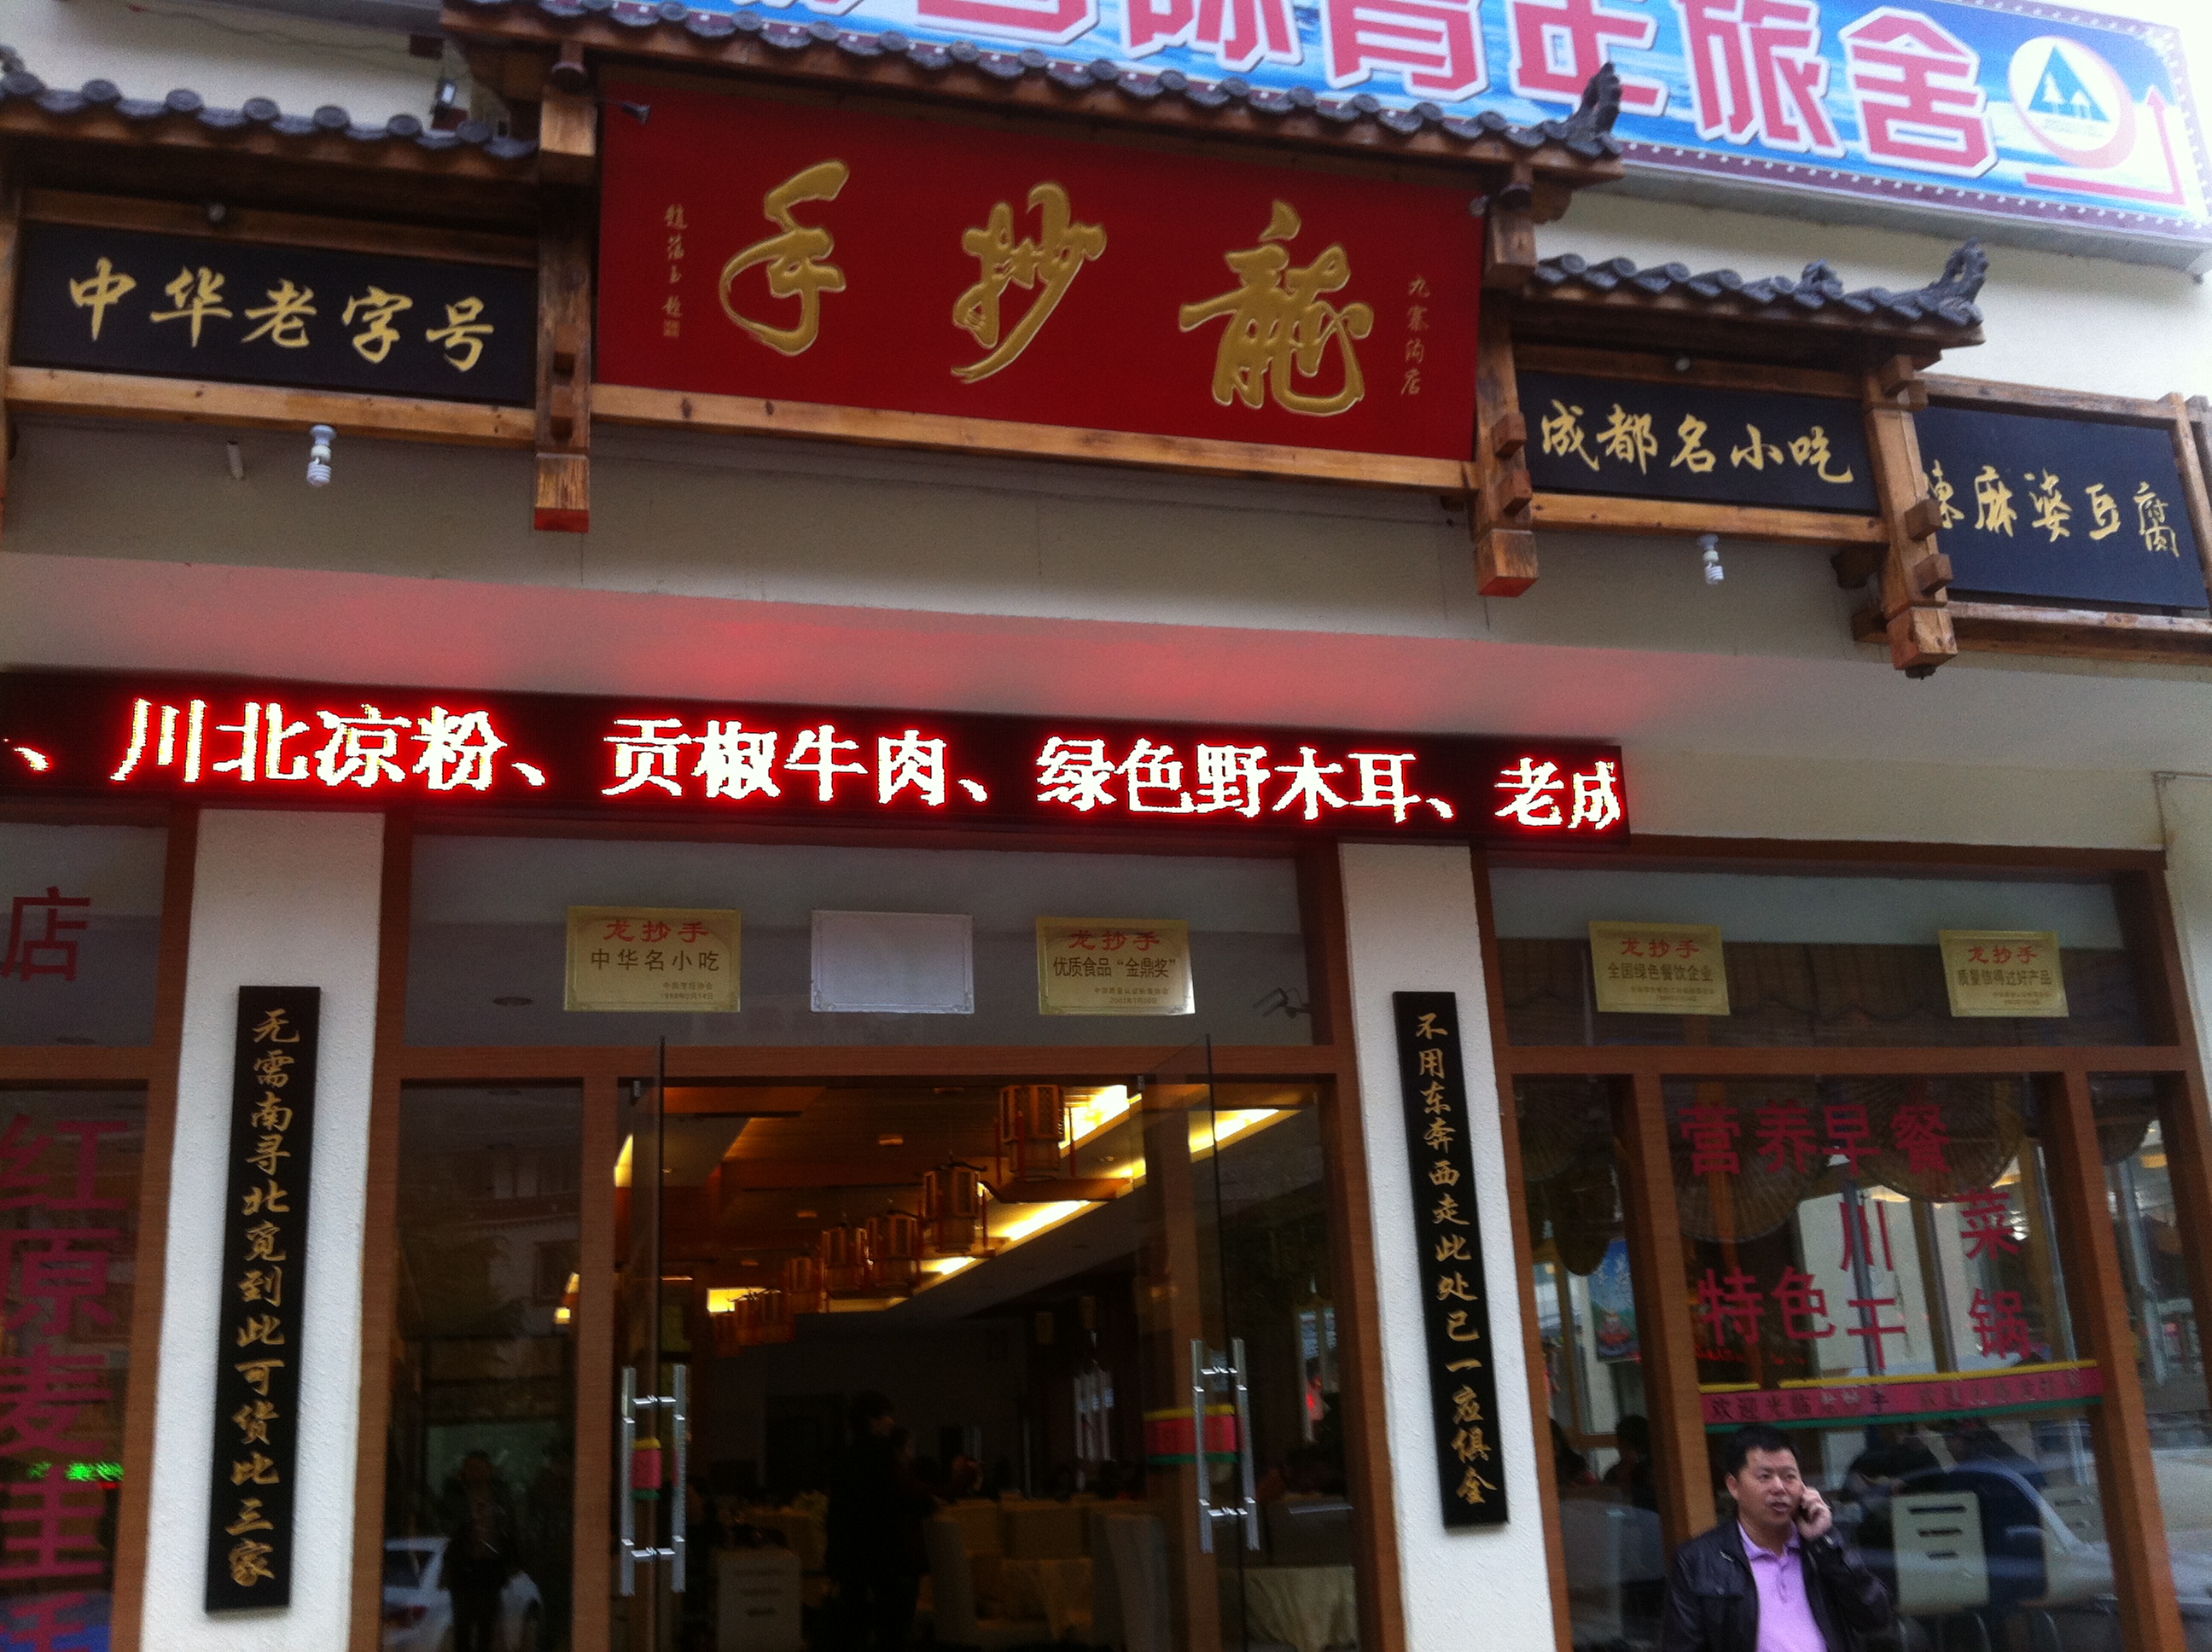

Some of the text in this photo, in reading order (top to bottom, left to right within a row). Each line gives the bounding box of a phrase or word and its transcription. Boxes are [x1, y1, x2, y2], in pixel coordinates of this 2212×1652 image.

[69, 257, 495, 373] 中华老字号
[1540, 400, 1854, 484] 成都名小吃
[602, 920, 709, 943] 龙抄手
[1068, 929, 1160, 951] 龙抄手
[1621, 937, 1700, 959] 龙抄手
[1968, 945, 2038, 964] 龙抄手
[591, 948, 719, 972] 中华名小吃
[1678, 1101, 1951, 1176] 营养早餐
